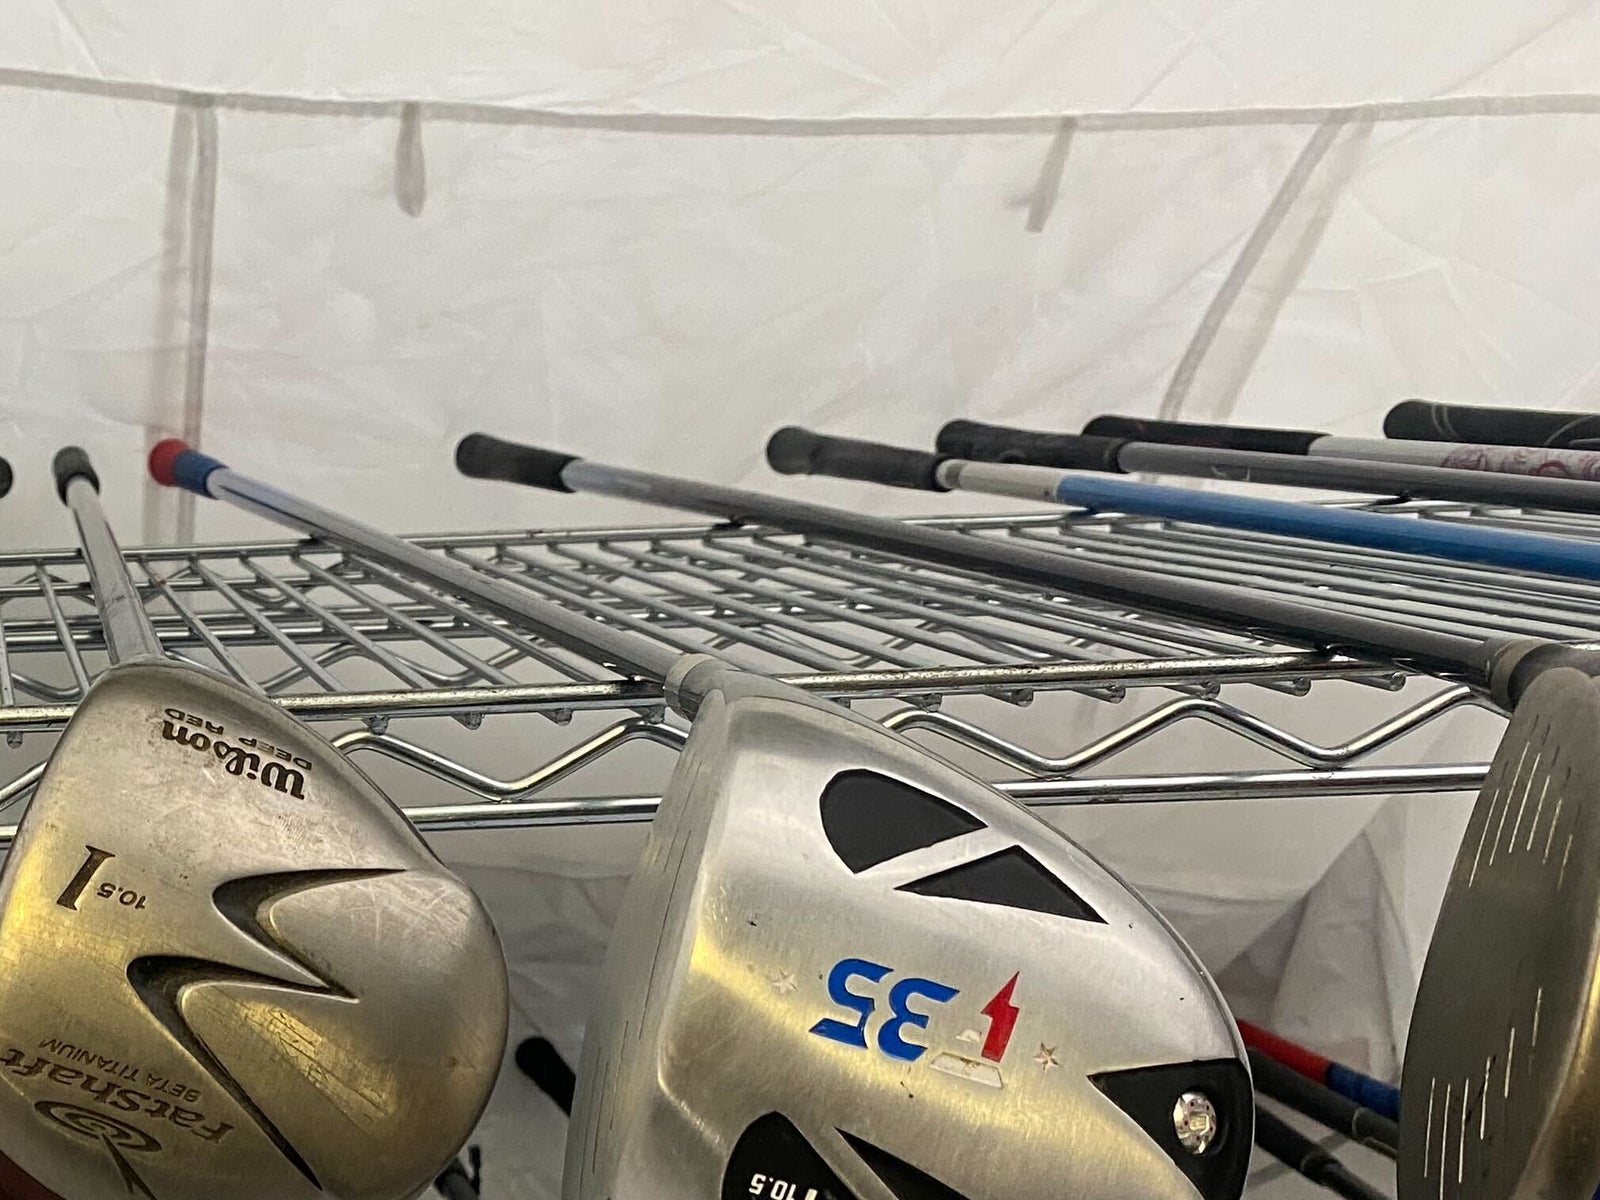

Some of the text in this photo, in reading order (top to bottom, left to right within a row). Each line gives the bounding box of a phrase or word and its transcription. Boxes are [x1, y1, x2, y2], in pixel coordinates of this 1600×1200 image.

[162, 719, 307, 801] Wilson
[165, 707, 313, 771] DEEP RED
[96, 884, 147, 911] 10.5
[37, 1036, 202, 1103] BETA TITANIUM
